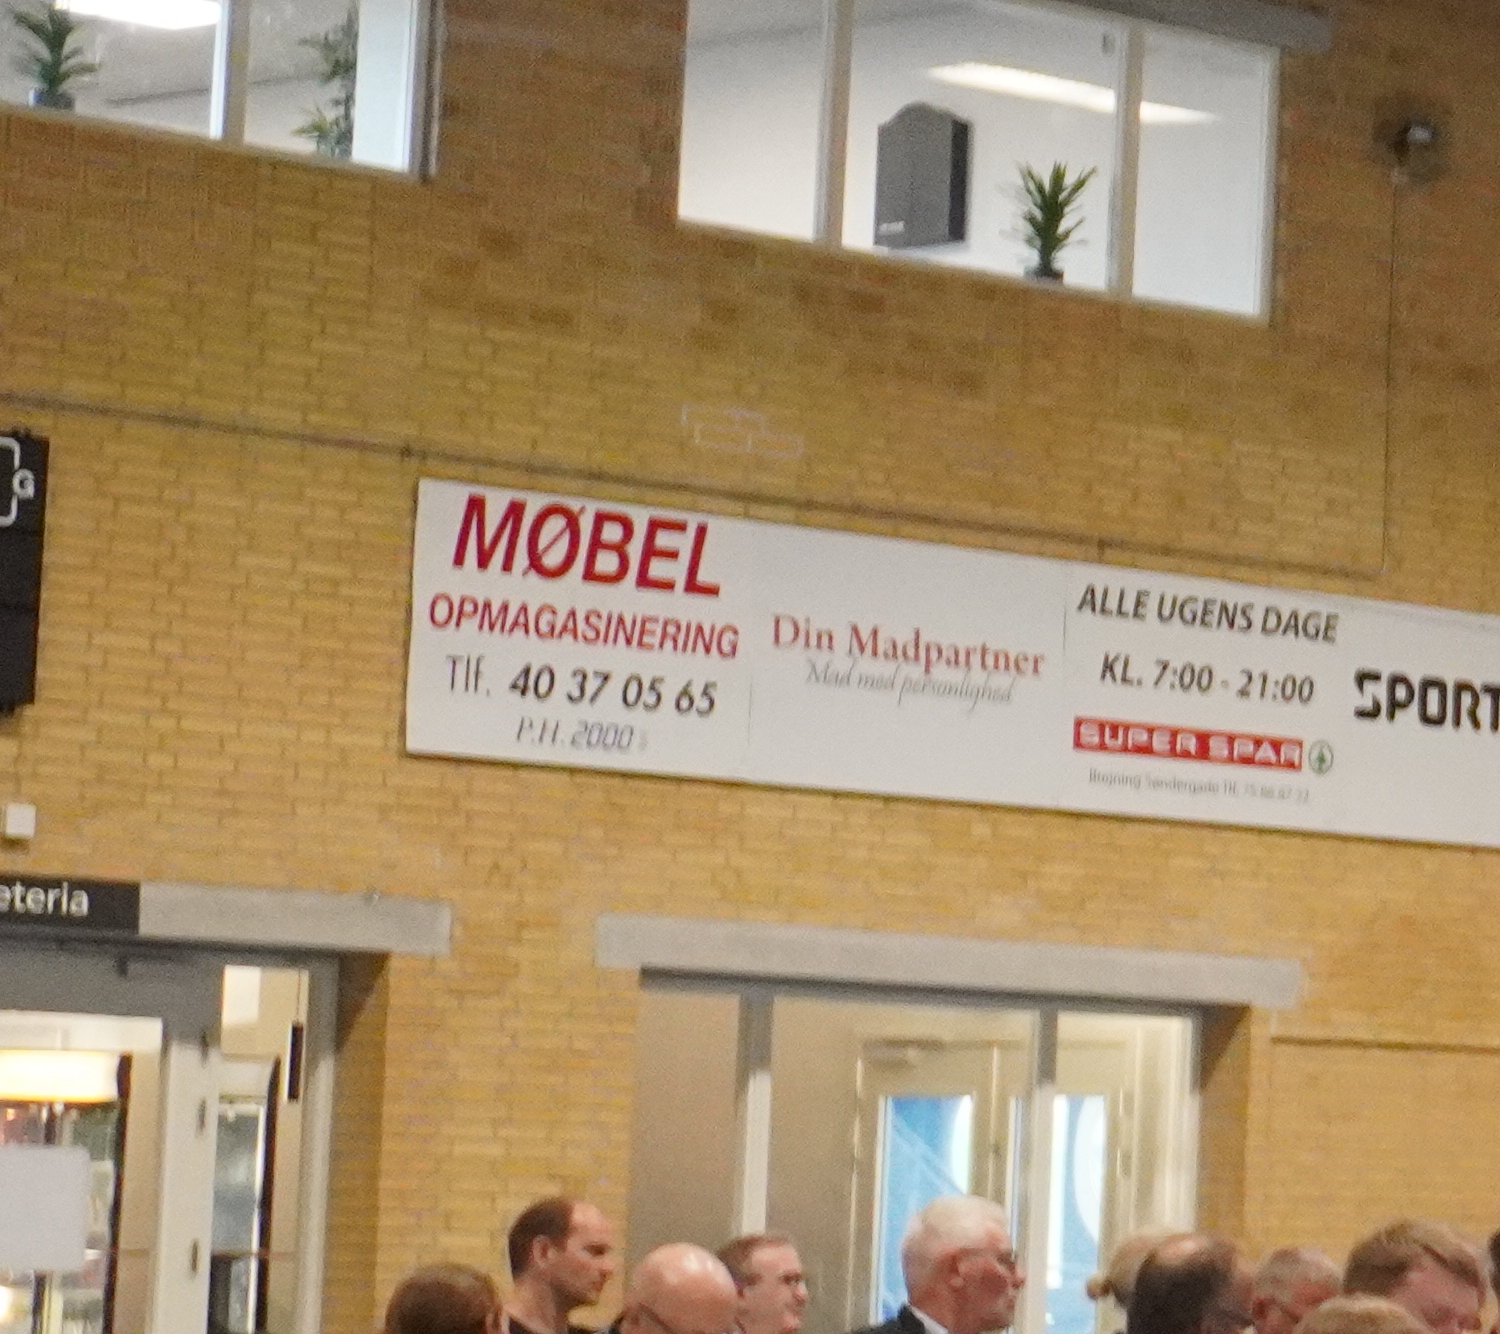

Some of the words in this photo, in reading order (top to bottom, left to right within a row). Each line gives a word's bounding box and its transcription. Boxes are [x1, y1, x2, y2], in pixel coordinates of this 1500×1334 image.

[452, 492, 721, 598] MØBEL
[429, 592, 740, 659] OPMAGASINERING
[1077, 583, 1151, 621] ALLE
[1156, 592, 1254, 633] UGENS
[1260, 604, 1340, 644] DAGE
[772, 612, 835, 651] Din
[848, 620, 1045, 678] Madpartner
[447, 654, 490, 697] Tlf.
[508, 663, 556, 700] 40
[566, 668, 612, 706] 37
[621, 673, 665, 712] 05
[674, 680, 719, 718] 65
[1099, 651, 1143, 687] KL.
[1153, 659, 1214, 694] 7:00
[1236, 667, 1315, 705] 21:00
[571, 720, 635, 750] 2000
[1078, 721, 1198, 757] SUPER
[1207, 734, 1301, 769] SPAR
